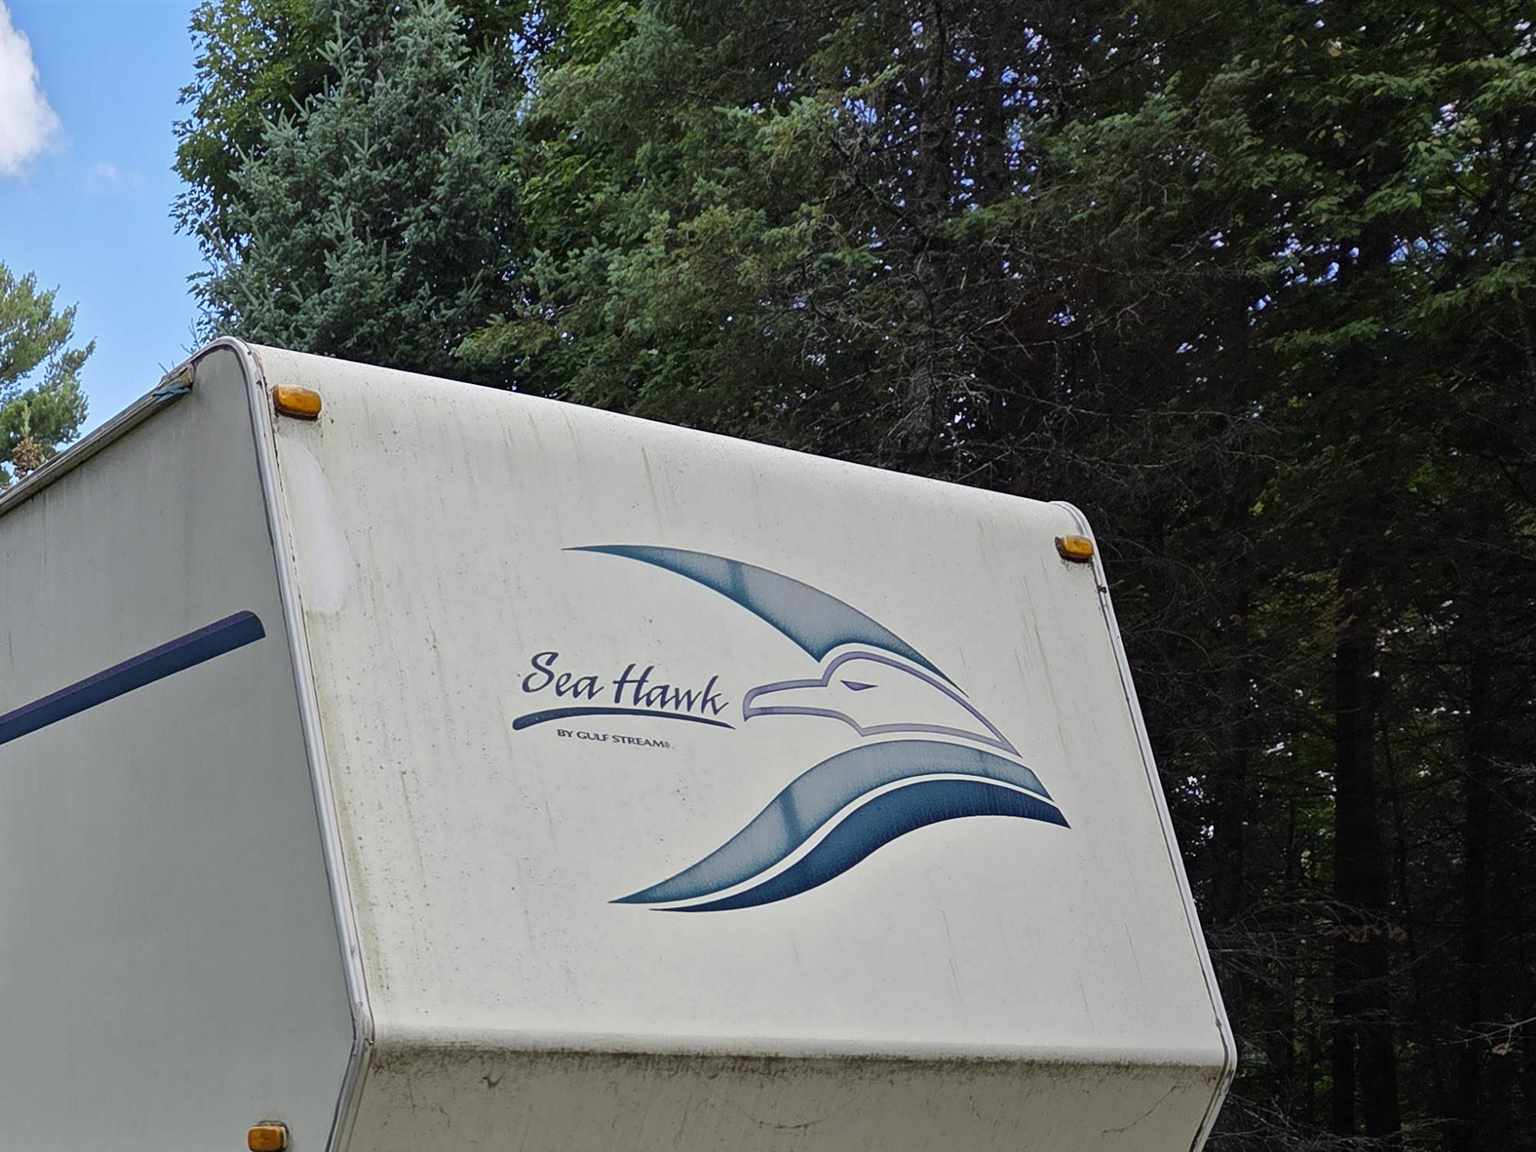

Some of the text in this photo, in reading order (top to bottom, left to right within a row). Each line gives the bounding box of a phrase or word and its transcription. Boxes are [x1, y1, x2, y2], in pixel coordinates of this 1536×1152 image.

[521, 651, 729, 716] Sea Hawk
[557, 728, 573, 738] BY
[576, 730, 609, 742] GULF
